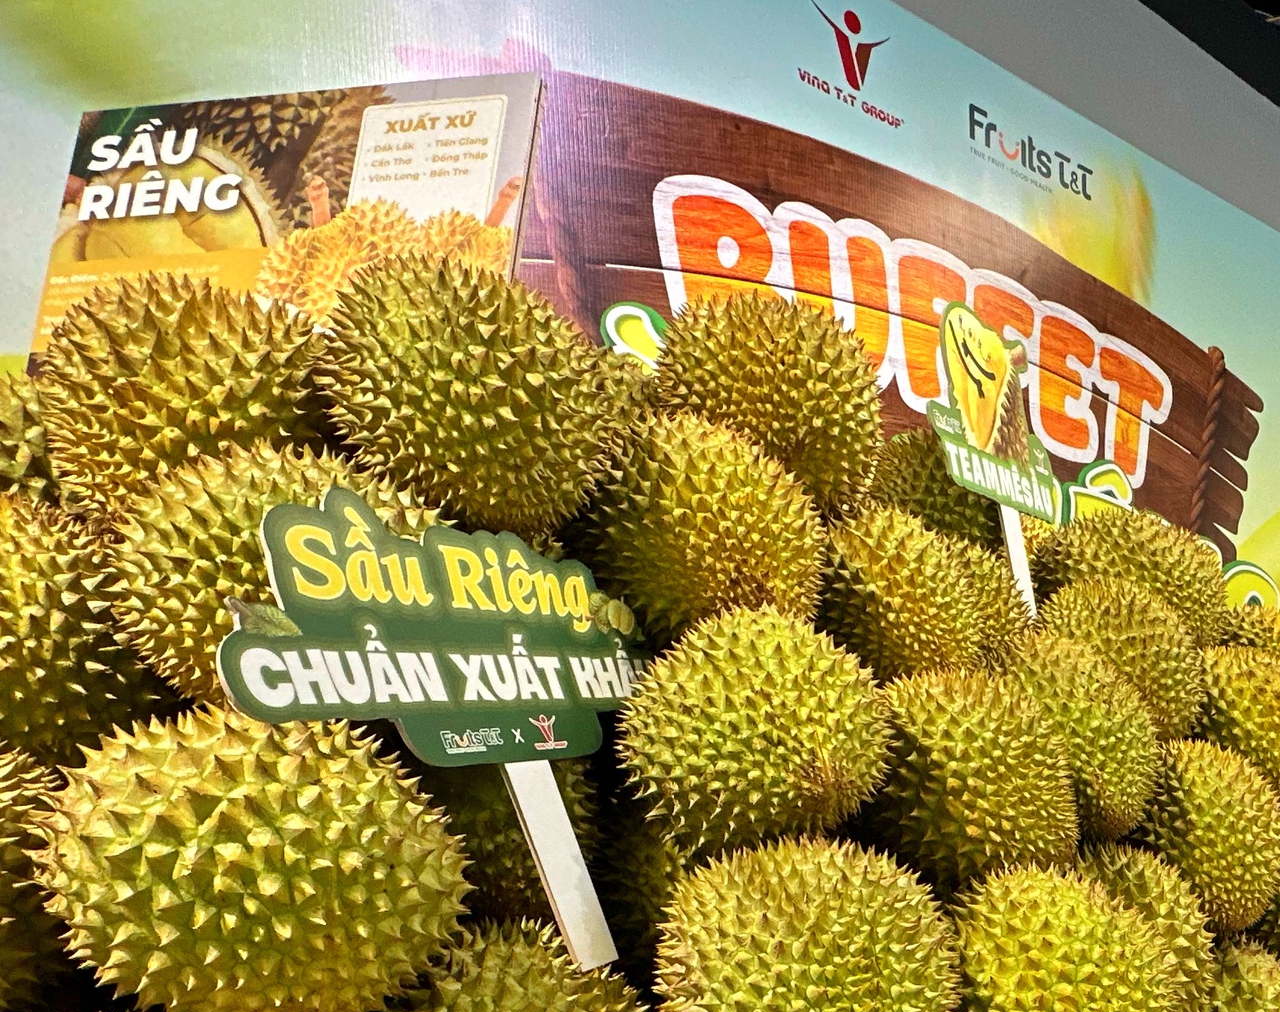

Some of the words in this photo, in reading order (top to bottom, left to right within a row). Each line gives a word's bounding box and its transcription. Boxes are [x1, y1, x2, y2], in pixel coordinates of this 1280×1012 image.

[385, 112, 440, 134] XUẤT
[445, 110, 477, 130] XỨ
[834, 86, 857, 107] T&T
[861, 101, 901, 129] GROUP
[87, 118, 198, 171] SẦU
[459, 137, 489, 147] Giang
[968, 103, 1052, 178] Fruits
[77, 170, 242, 221] RIÊNG
[970, 146, 986, 160] TRUE
[987, 156, 1005, 170] FRUIT
[1009, 167, 1029, 182] GOOD
[1030, 178, 1053, 194] HEALTH
[285, 506, 435, 607] Sầu
[438, 543, 593, 632] Riêng
[240, 624, 448, 707] CHUẨN
[449, 634, 565, 701] XUẤT
